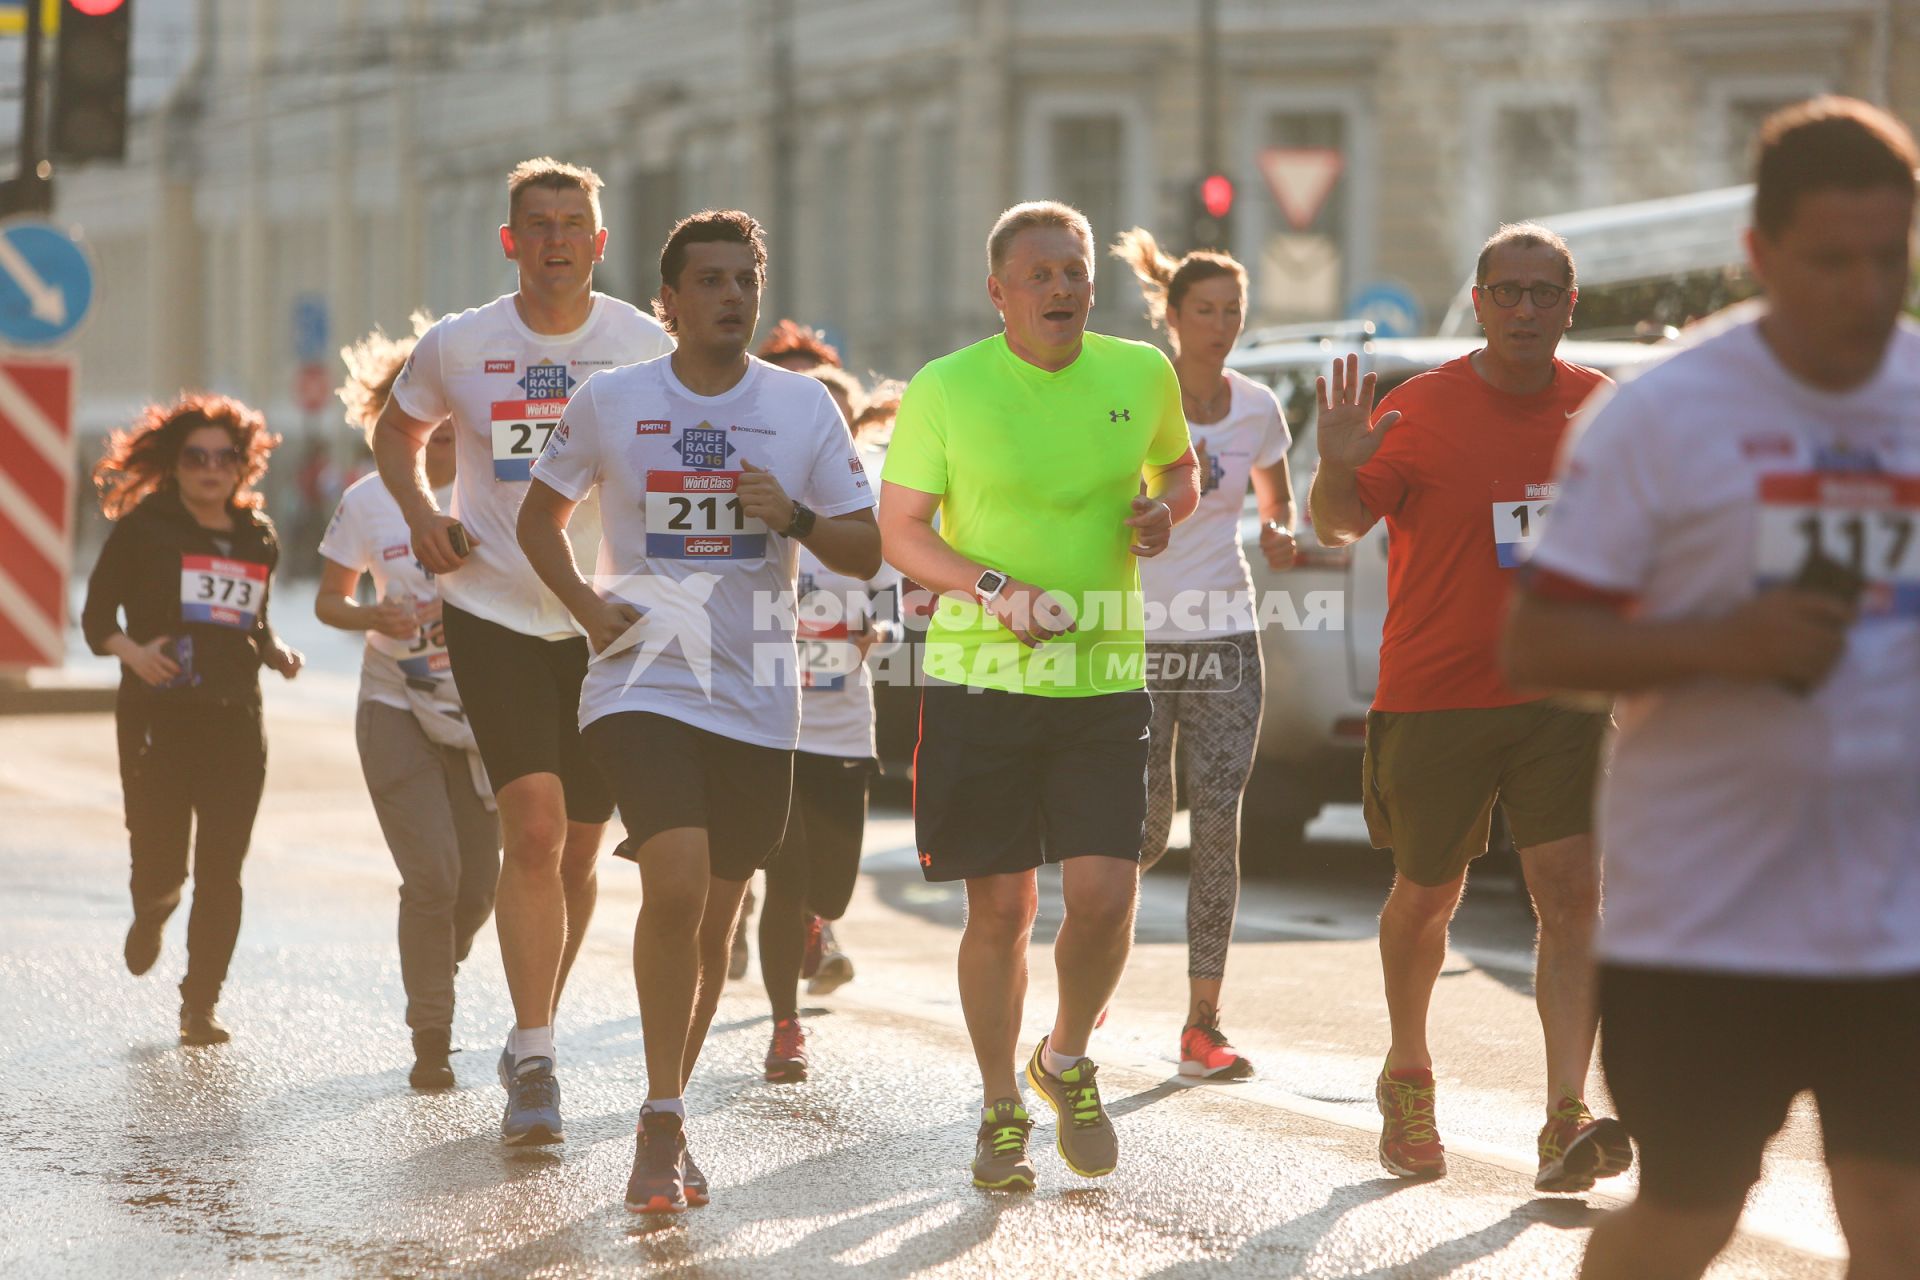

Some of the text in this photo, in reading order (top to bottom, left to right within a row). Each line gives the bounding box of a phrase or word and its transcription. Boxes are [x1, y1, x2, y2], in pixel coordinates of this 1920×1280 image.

[529, 367, 564, 378] SPIEF
[529, 378, 564, 388] RACE
[529, 388, 564, 398] 2016
[510, 423, 557, 454] 27
[686, 431, 723, 442] SPIEF
[686, 442, 723, 454] RACE
[685, 453, 722, 465] 2016
[685, 477, 732, 489] World Class
[1527, 485, 1548, 497] World
[668, 496, 744, 530] 211
[686, 545, 730, 553] СПОРТ
[197, 574, 252, 606] 373
